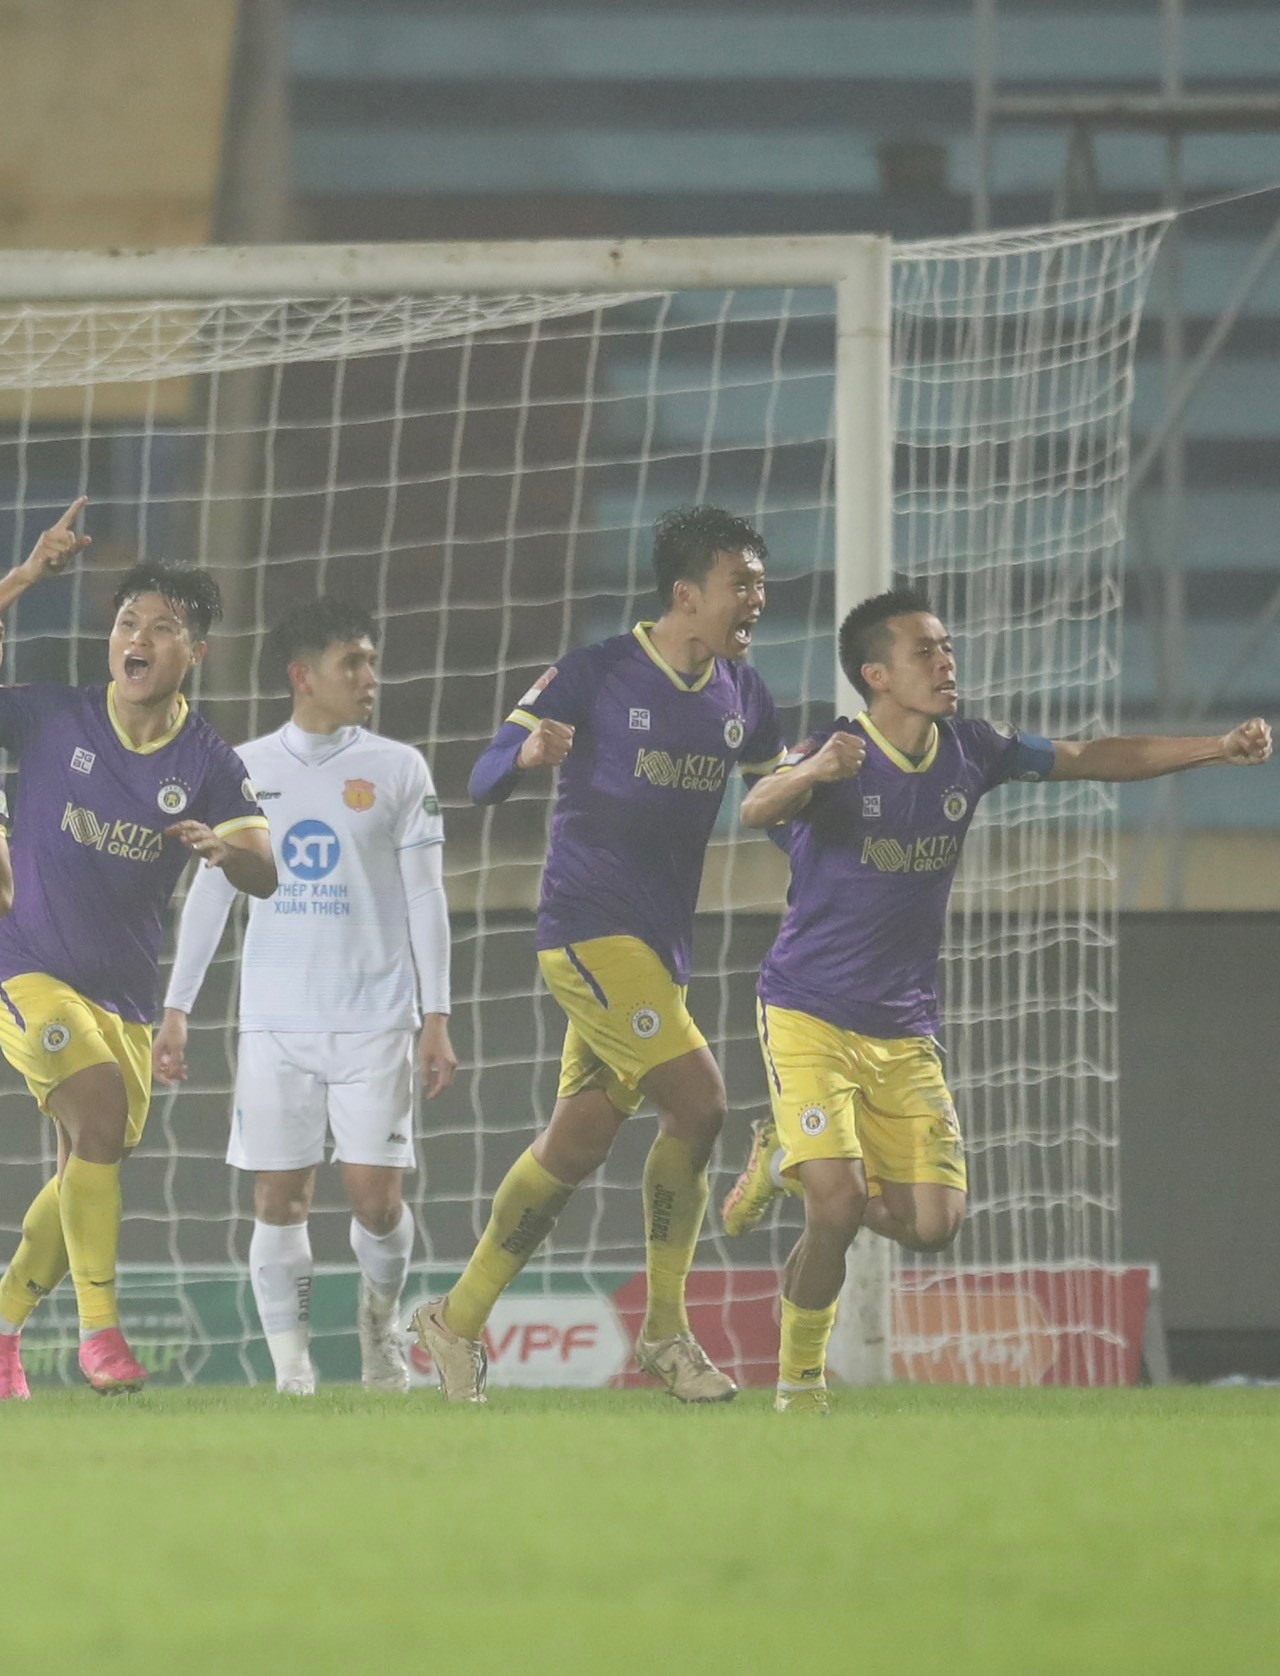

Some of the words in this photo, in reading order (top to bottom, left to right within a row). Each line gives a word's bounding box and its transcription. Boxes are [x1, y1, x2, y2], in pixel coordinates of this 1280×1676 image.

[684, 753, 725, 778] KITA
[111, 819, 163, 851] KITA
[915, 835, 957, 858] KITA
[107, 841, 160, 863] GROUP
[288, 835, 336, 868] XT
[312, 884, 348, 897] XANH
[482, 1324, 600, 1363] VPF
